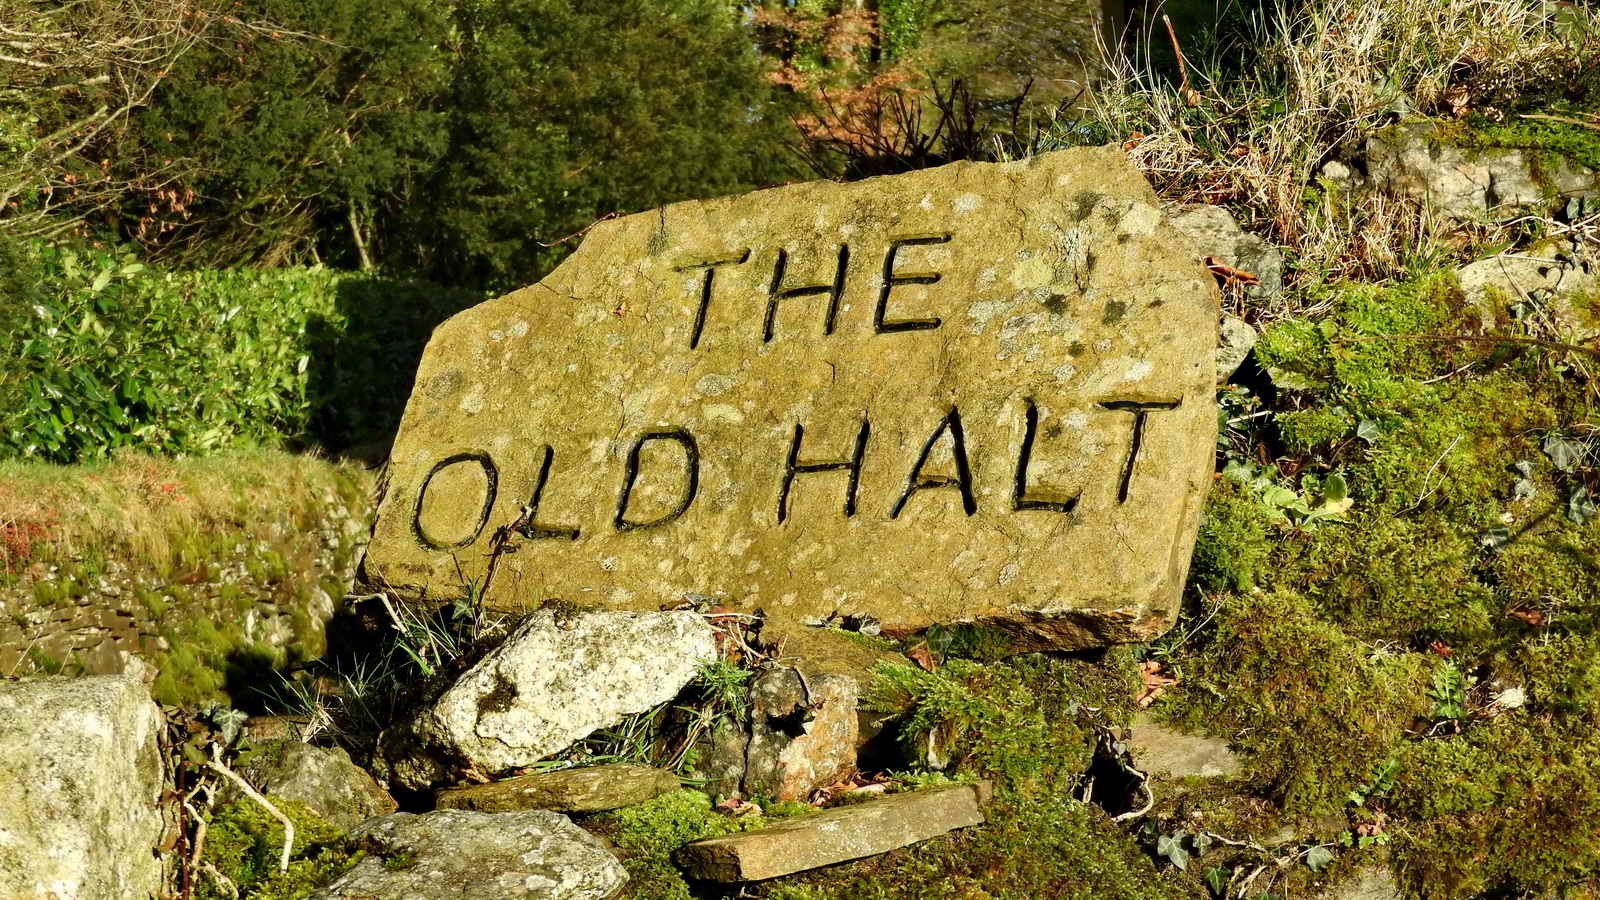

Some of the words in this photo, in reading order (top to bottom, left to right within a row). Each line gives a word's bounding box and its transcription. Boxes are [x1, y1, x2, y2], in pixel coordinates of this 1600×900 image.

[673, 233, 952, 350] THE
[410, 427, 700, 551] OLD
[777, 396, 1183, 524] HALT
